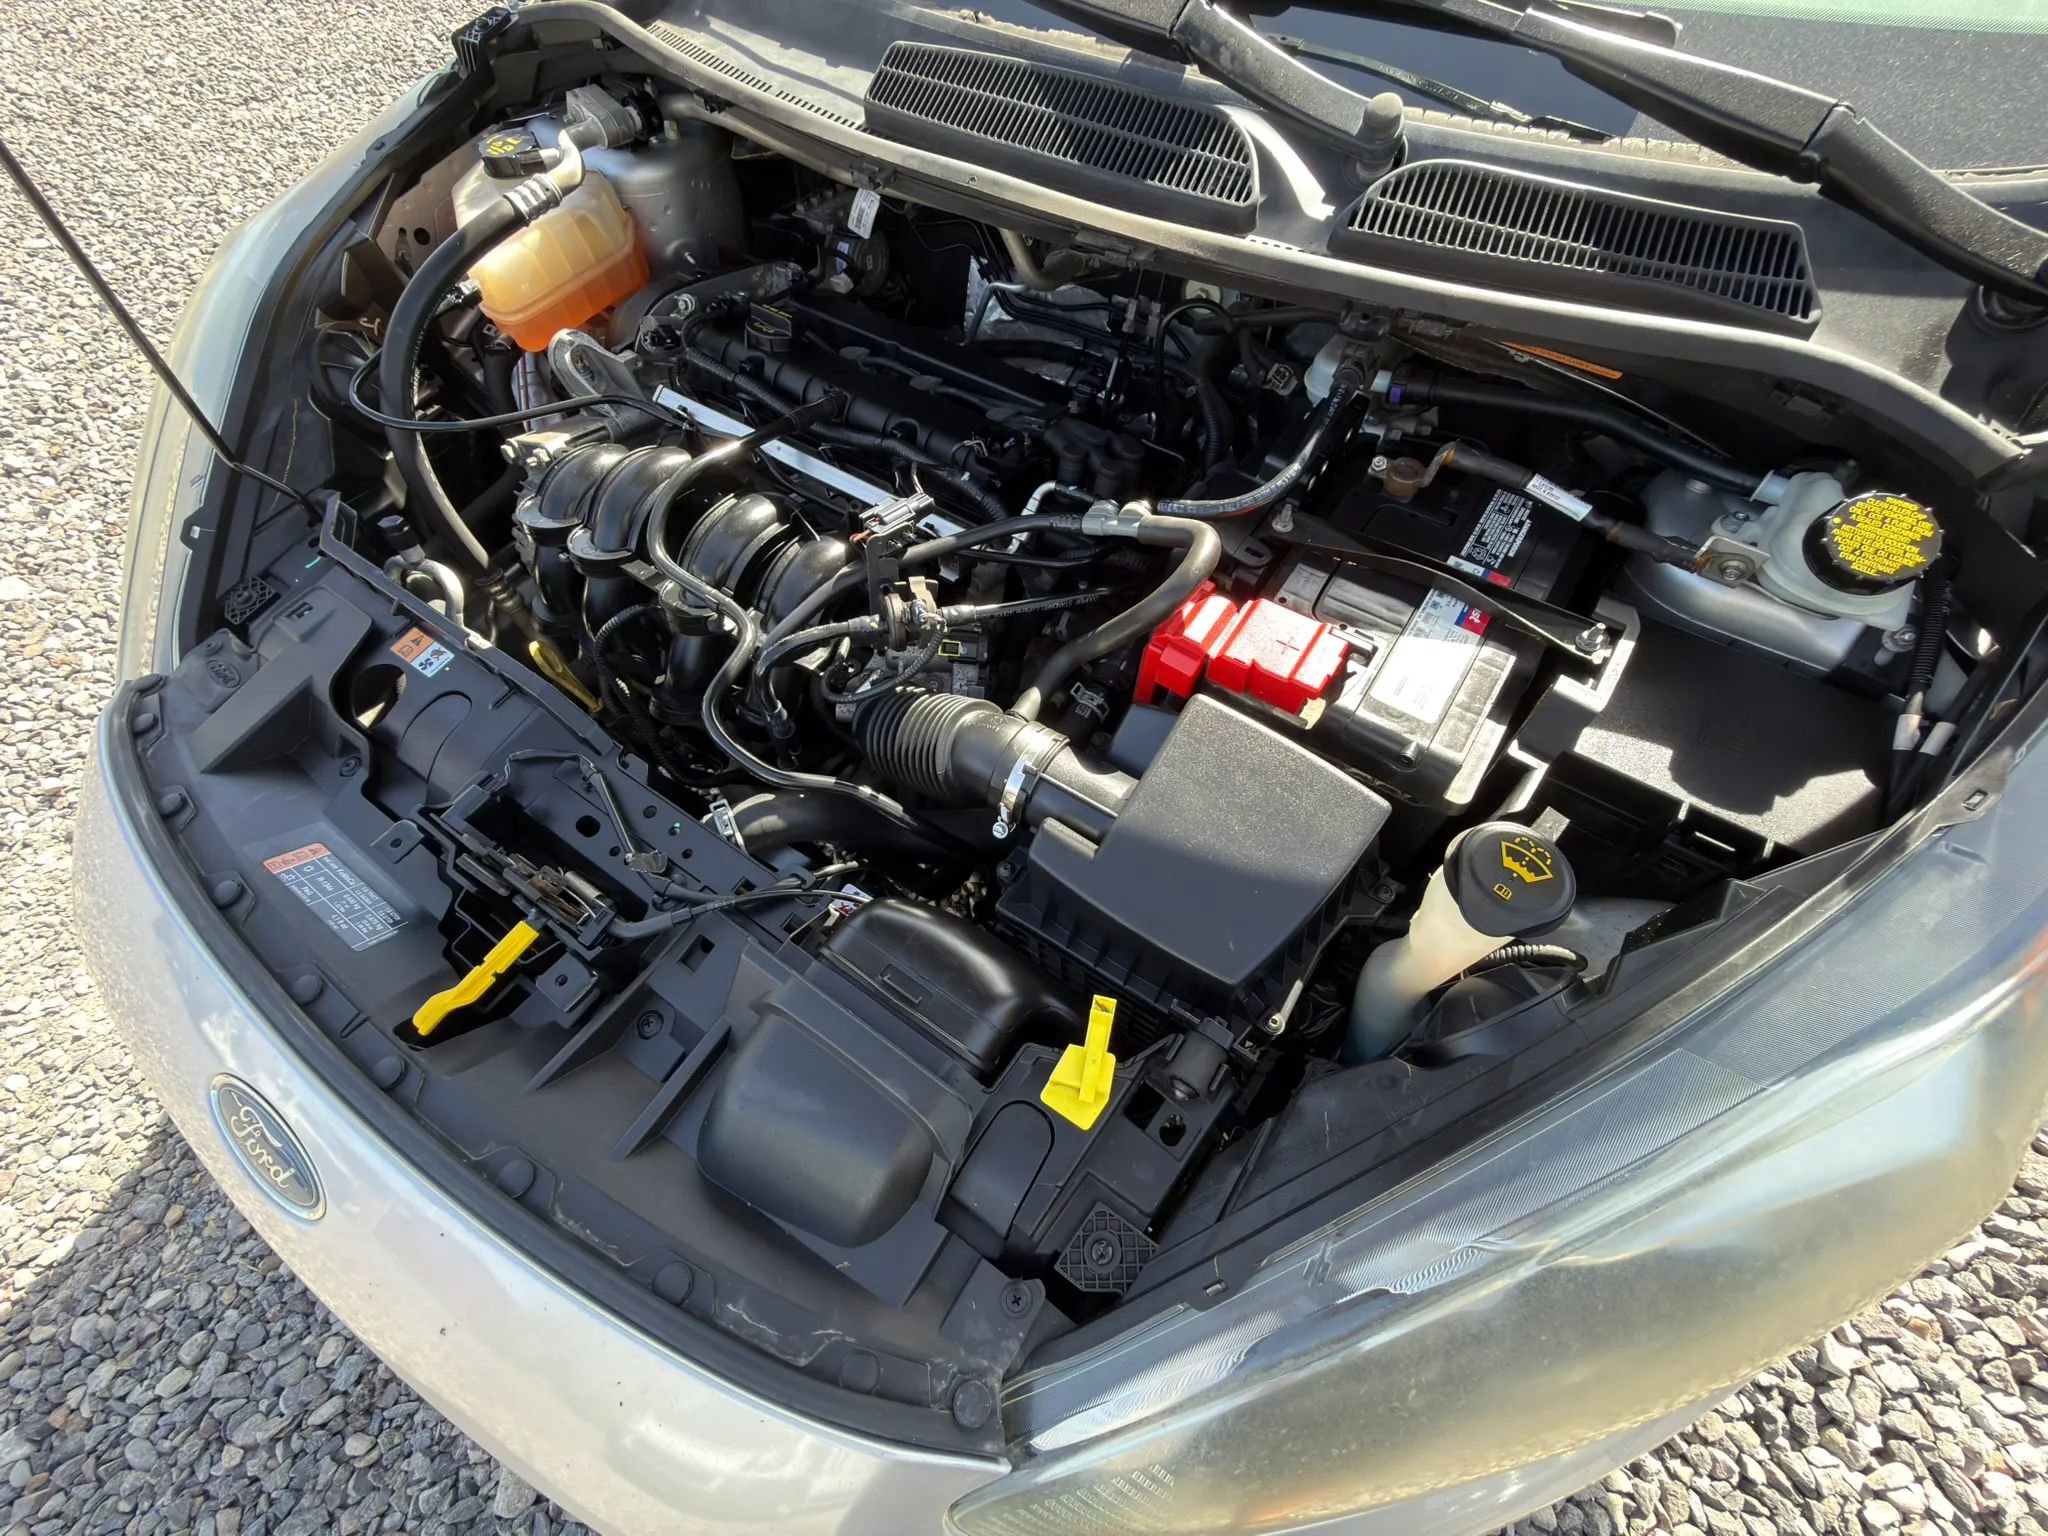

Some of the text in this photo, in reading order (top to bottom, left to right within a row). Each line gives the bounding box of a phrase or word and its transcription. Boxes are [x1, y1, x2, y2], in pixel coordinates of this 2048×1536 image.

[1867, 511, 1883, 520] DOT
[1891, 519, 1910, 529] FLUID
[1837, 543, 1853, 553] DOT
[229, 1091, 297, 1189] Ford
